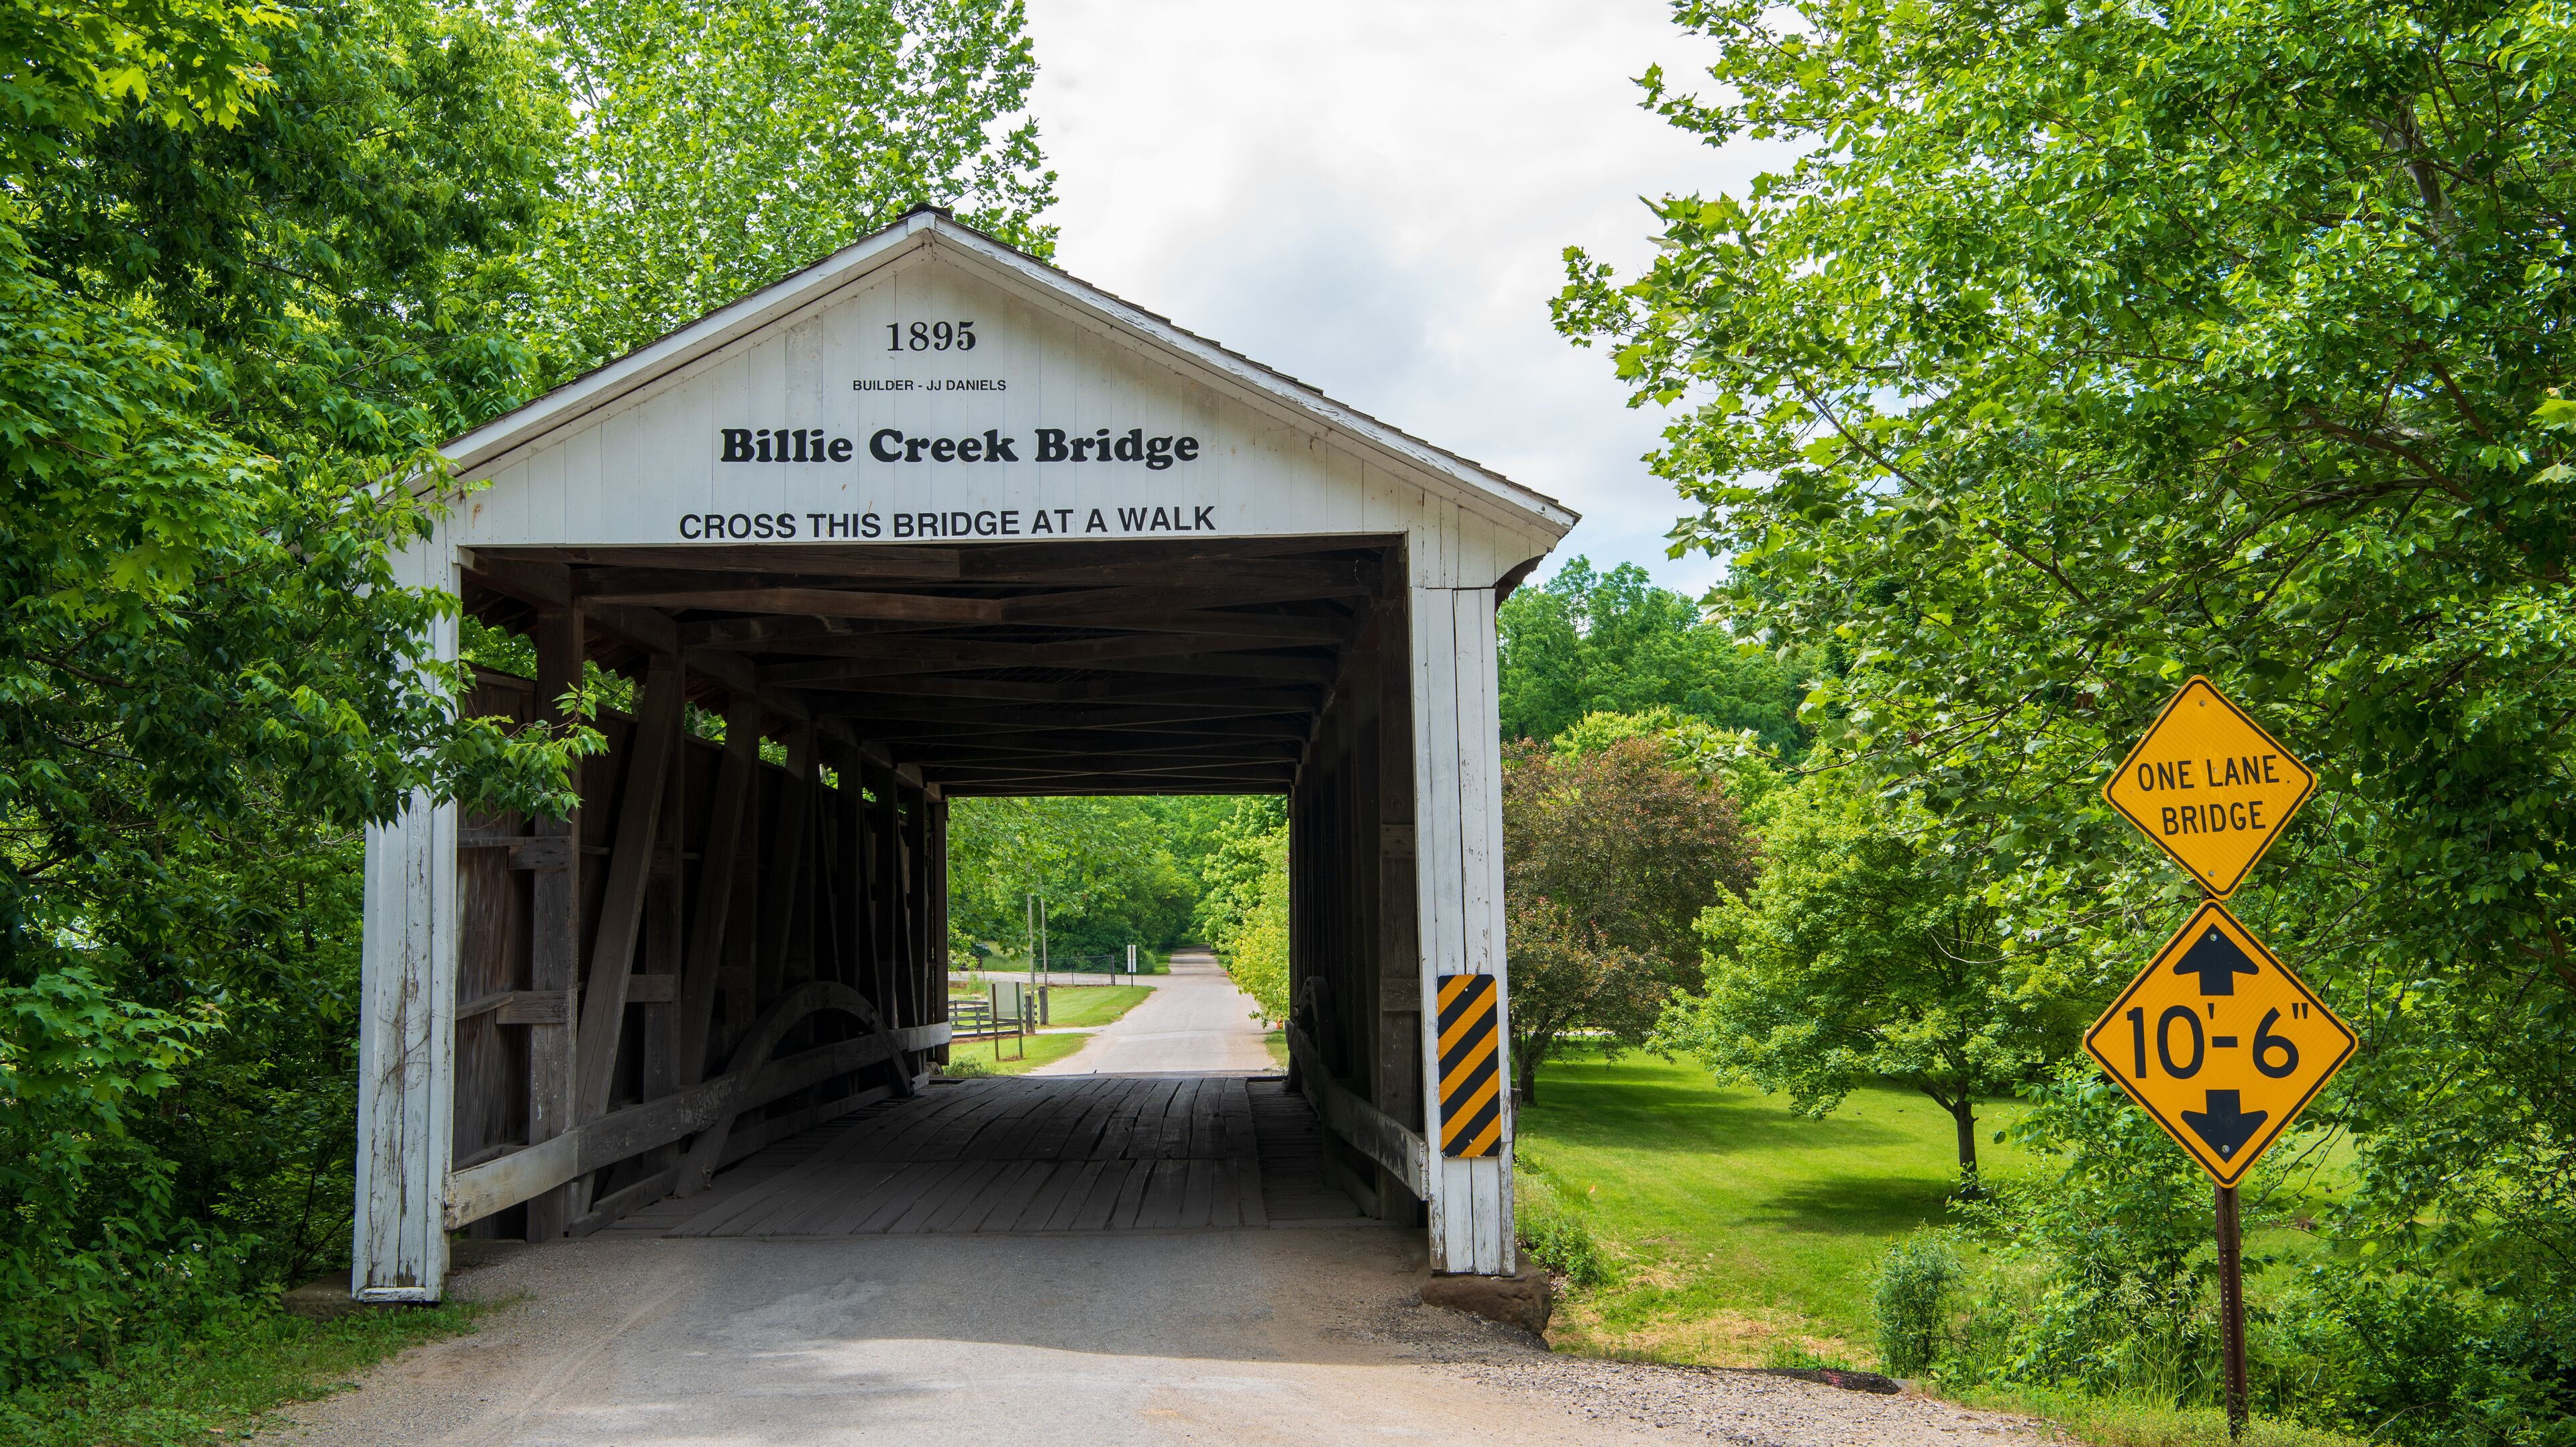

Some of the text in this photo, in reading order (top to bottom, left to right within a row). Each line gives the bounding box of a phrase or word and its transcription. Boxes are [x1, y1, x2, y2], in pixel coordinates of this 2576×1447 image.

[886, 321, 976, 352] 1895
[853, 380, 914, 391] BUILDER
[926, 380, 941, 391] JJ
[946, 380, 1007, 391] DANIELS
[720, 428, 1199, 471] Billie Creek Bridge
[680, 506, 1216, 539] CROSS THIS BRIDGE AT A WALK
[2138, 755, 2280, 792] ONE LANE
[2161, 800, 2266, 835] BRIDGE
